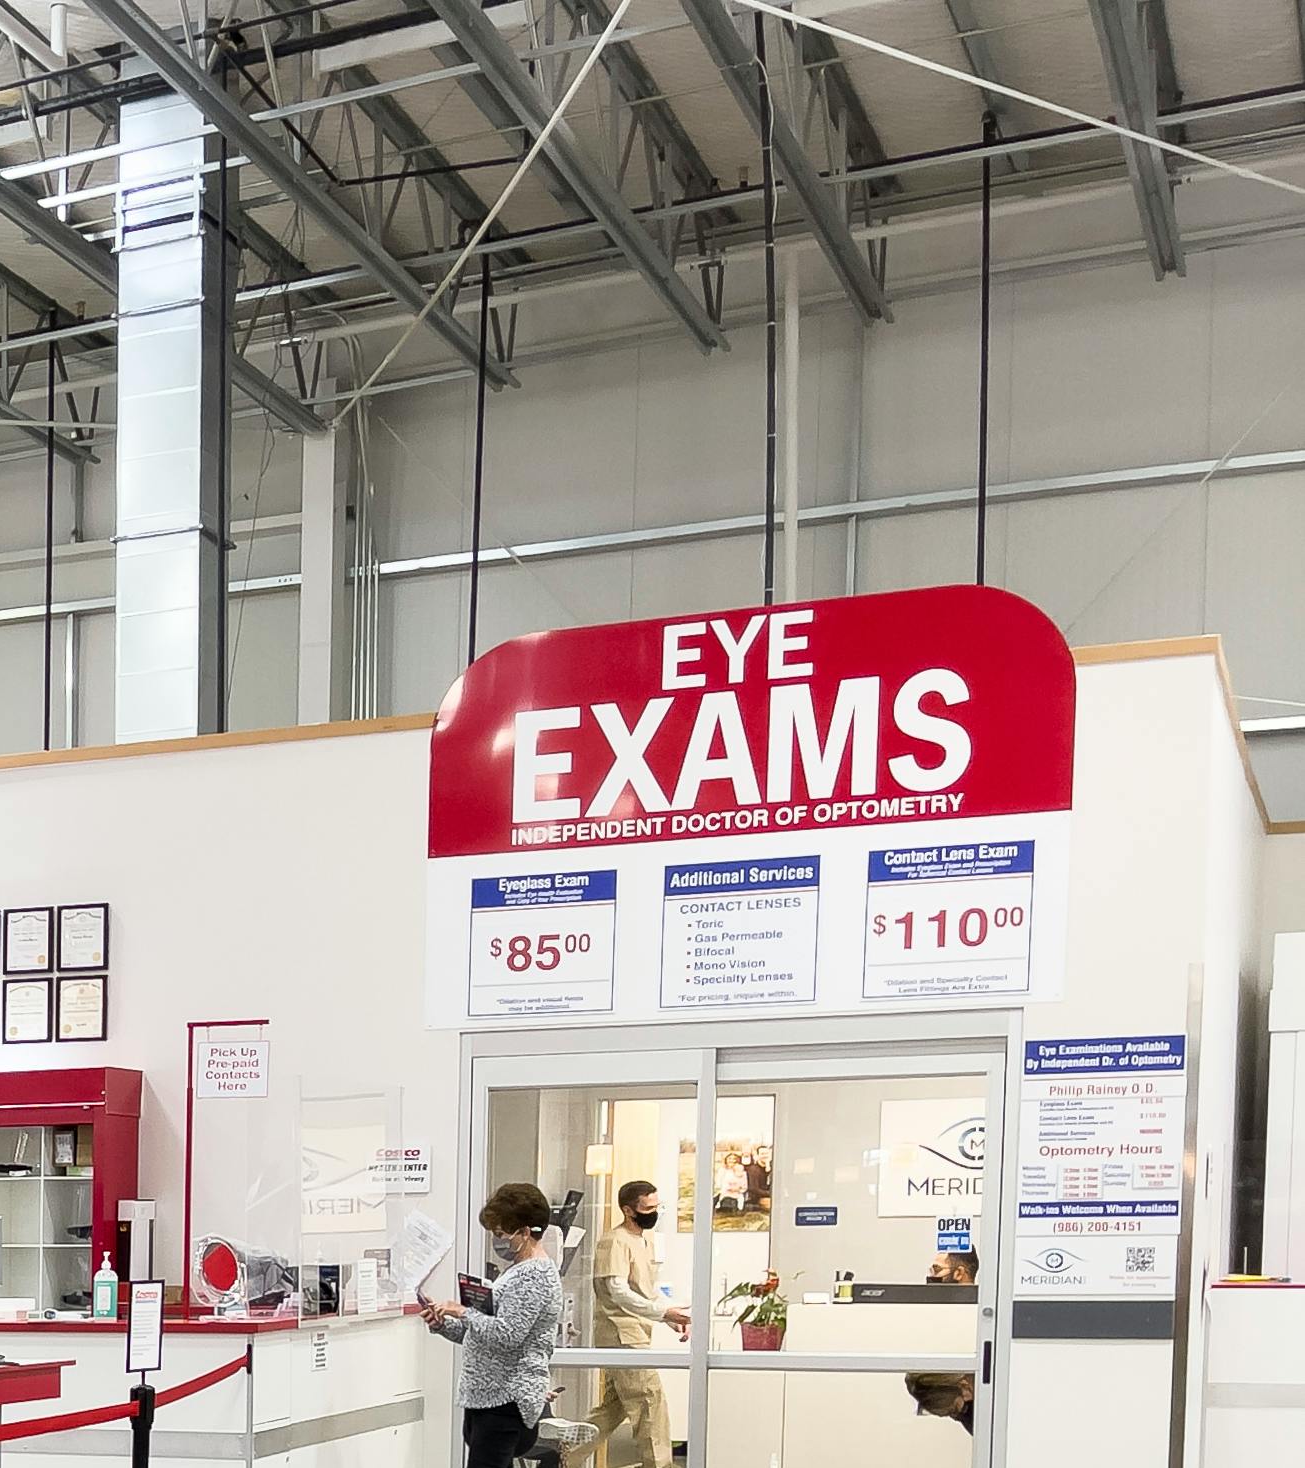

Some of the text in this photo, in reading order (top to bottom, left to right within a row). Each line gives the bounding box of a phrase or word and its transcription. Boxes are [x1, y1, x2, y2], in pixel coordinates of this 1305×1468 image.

[662, 609, 815, 691] EYE
[512, 667, 973, 824] EXAMS
[511, 792, 965, 847] INDEPENDENT DOCTOR OF OPTOMETRY
[884, 844, 1018, 866] Contact Lens Exam
[670, 865, 814, 888] Additional Services
[498, 875, 590, 893] Eyeglass Exam
[680, 897, 802, 914] CONTACT LENSES
[695, 919, 724, 929] Toric
[694, 930, 783, 943] Gas Permeable
[694, 946, 735, 957] Bifocal
[694, 959, 766, 971] Mono Vision
[693, 972, 794, 986] Specialty Lenses
[210, 1047, 257, 1058] Pick Up
[1039, 1041, 1171, 1057] Eye Examinations Available
[208, 1058, 259, 1069] Pre-paid
[1026, 1054, 1182, 1071] By Independent Dr. of Optometry
[206, 1071, 260, 1080] Contacts
[218, 1081, 247, 1090] Here
[1049, 1085, 1083, 1097] Philip
[1087, 1084, 1127, 1096] Rainey
[1039, 1144, 1163, 1158] Optometry Hours
[1021, 1203, 1177, 1215] Walk-ins Welcome When Available
[938, 1218, 971, 1231] OPEN
[1021, 1275, 1083, 1285] MERIDIAN
[861, 1289, 885, 1297] acer
